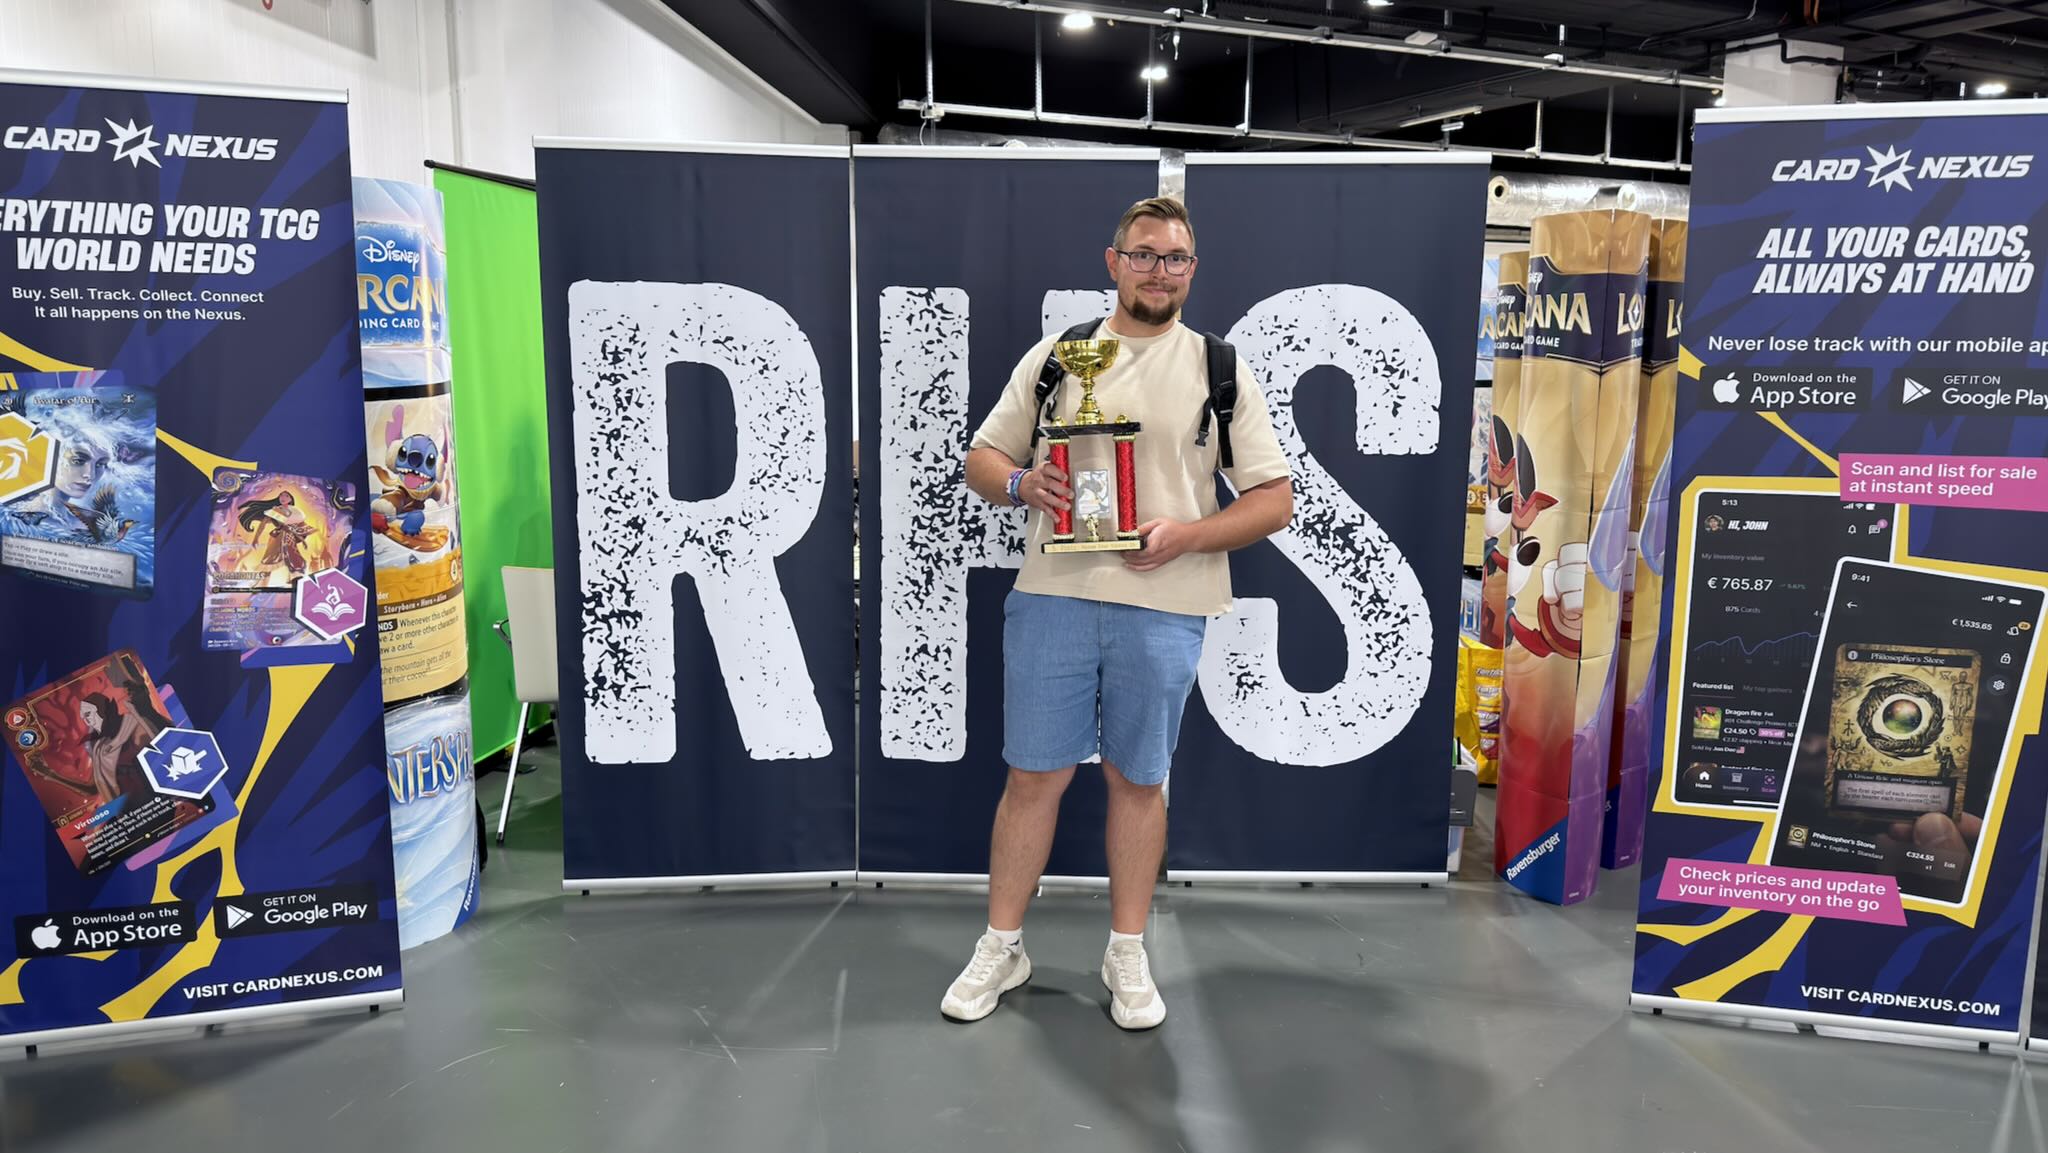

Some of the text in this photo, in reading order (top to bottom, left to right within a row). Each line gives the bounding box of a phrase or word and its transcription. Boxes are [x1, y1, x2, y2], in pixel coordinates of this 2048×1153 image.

[3, 126, 279, 161] CARD NEXUS
[1771, 155, 2034, 182] CARD NEXUS
[164, 204, 250, 238] YOUR
[259, 208, 320, 240] TCG
[1756, 225, 2031, 262] ALL YOUR CARDS,
[16, 237, 256, 275] WORLD NEEDS
[1752, 261, 2034, 294] ALWAYS AT HAND
[12, 287, 264, 303] Buy. Sell. Track. Collect. Connect
[35, 306, 246, 321] It all happens on the Nexus.
[392, 318, 420, 328] CARD
[1536, 335, 1560, 347] GAME
[1708, 336, 1764, 351] Never
[1769, 336, 1809, 351] lose
[1814, 336, 1864, 351] track
[1869, 336, 1911, 352] with
[1917, 340, 1950, 353] our
[1955, 337, 2023, 353] mobile
[1753, 373, 1857, 384] Download on the
[1944, 375, 2001, 385] GET IT ON
[1750, 386, 1857, 407] App Store
[1942, 388, 2011, 409] Google
[1851, 462, 2037, 480] Scan and list for sale
[1849, 480, 1993, 499] at instant speed
[1742, 520, 1769, 531] JOHN
[1707, 577, 1773, 591] € 765.87
[1851, 573, 1870, 583] 9:41
[399, 615, 432, 628] Whenever
[74, 809, 110, 830] Virtuoso
[1506, 832, 1560, 880] Ravensburger
[1680, 866, 1886, 898] Check prices and update
[263, 893, 316, 907] GET IT ON
[1678, 885, 1880, 912] your inventory on the go
[72, 907, 179, 926] Download on the
[264, 902, 368, 925] Google Play
[73, 920, 182, 948] App Store
[183, 965, 383, 999] VISIT CARDNEXUS.COM
[1801, 985, 2001, 1016] VISIT CARDNEXUS.COM
